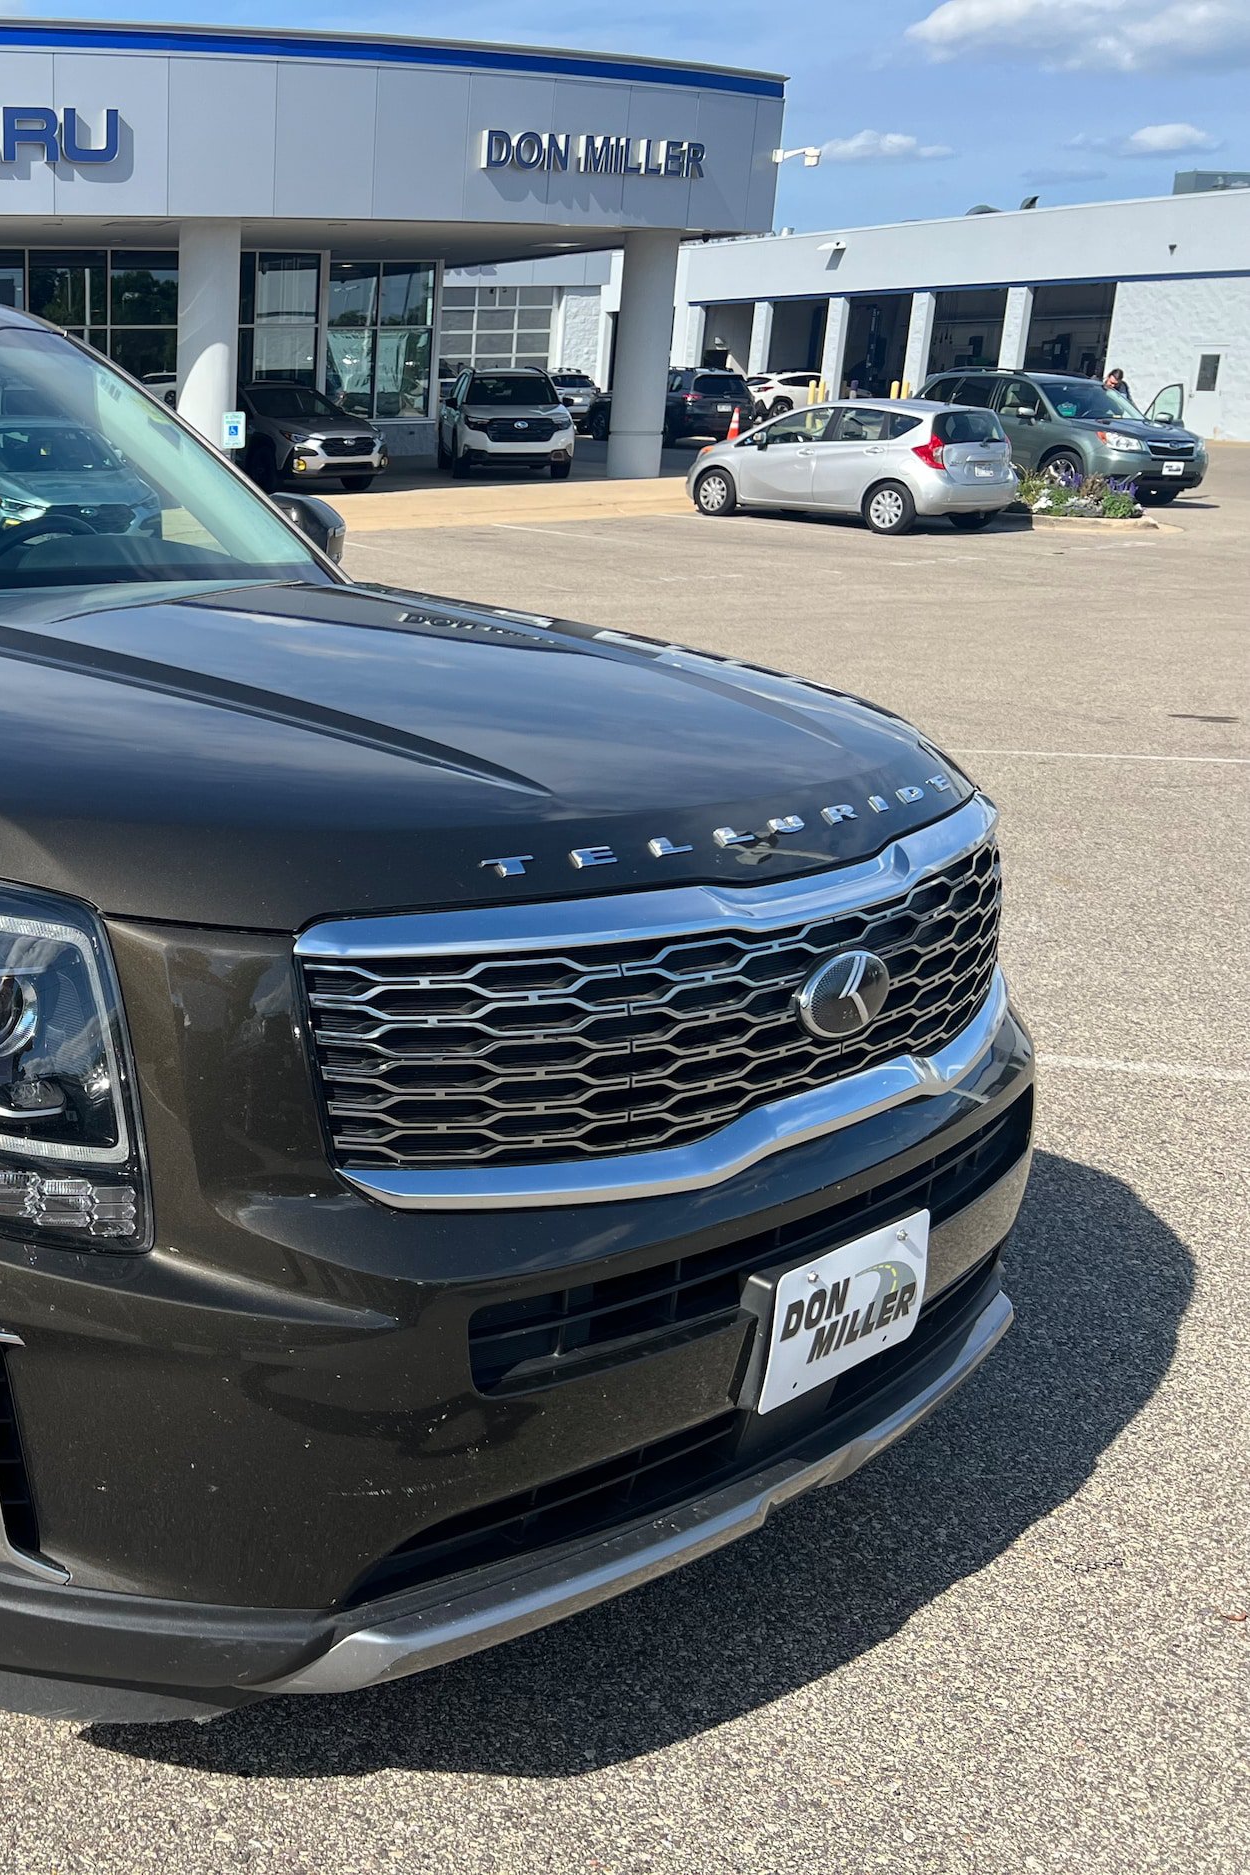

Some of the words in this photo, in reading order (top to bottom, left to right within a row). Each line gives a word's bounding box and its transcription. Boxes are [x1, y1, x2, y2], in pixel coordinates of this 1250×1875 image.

[480, 129, 571, 172] DON
[578, 134, 706, 178] MILLER
[478, 773, 950, 878] TELLURIDE
[780, 1277, 851, 1342] DON
[806, 1282, 917, 1365] MILLER
